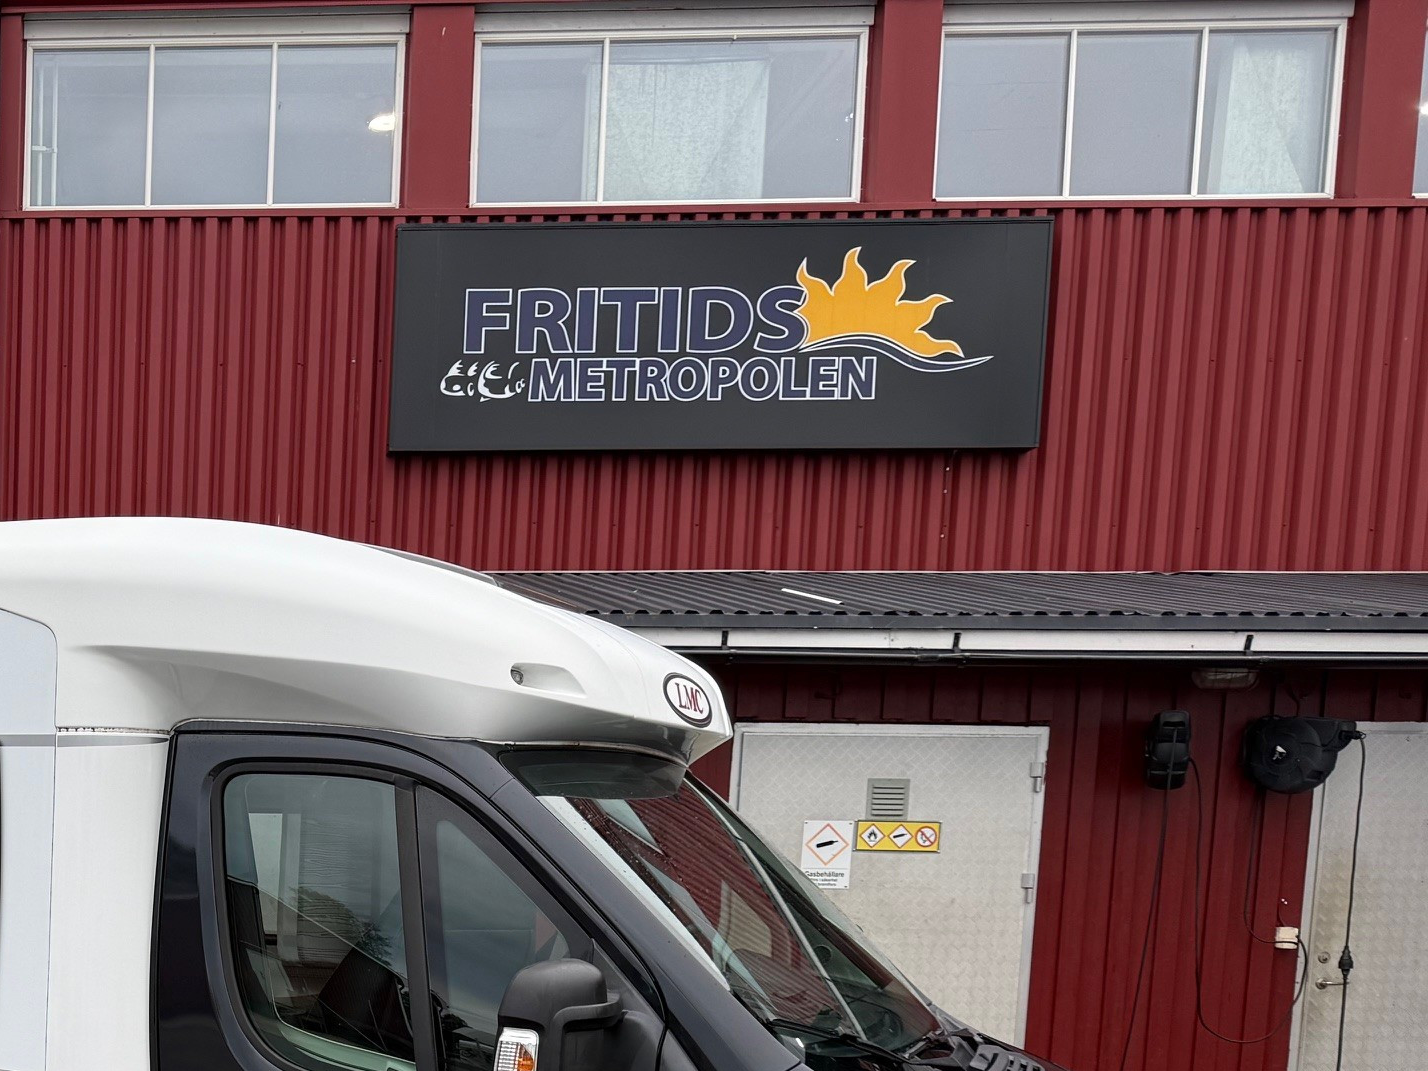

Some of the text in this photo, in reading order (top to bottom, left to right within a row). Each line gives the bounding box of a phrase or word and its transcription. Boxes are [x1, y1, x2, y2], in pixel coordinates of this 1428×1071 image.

[463, 286, 808, 354] FRITIDS
[527, 356, 876, 402] METROPOLEN
[674, 682, 704, 714] LMC
